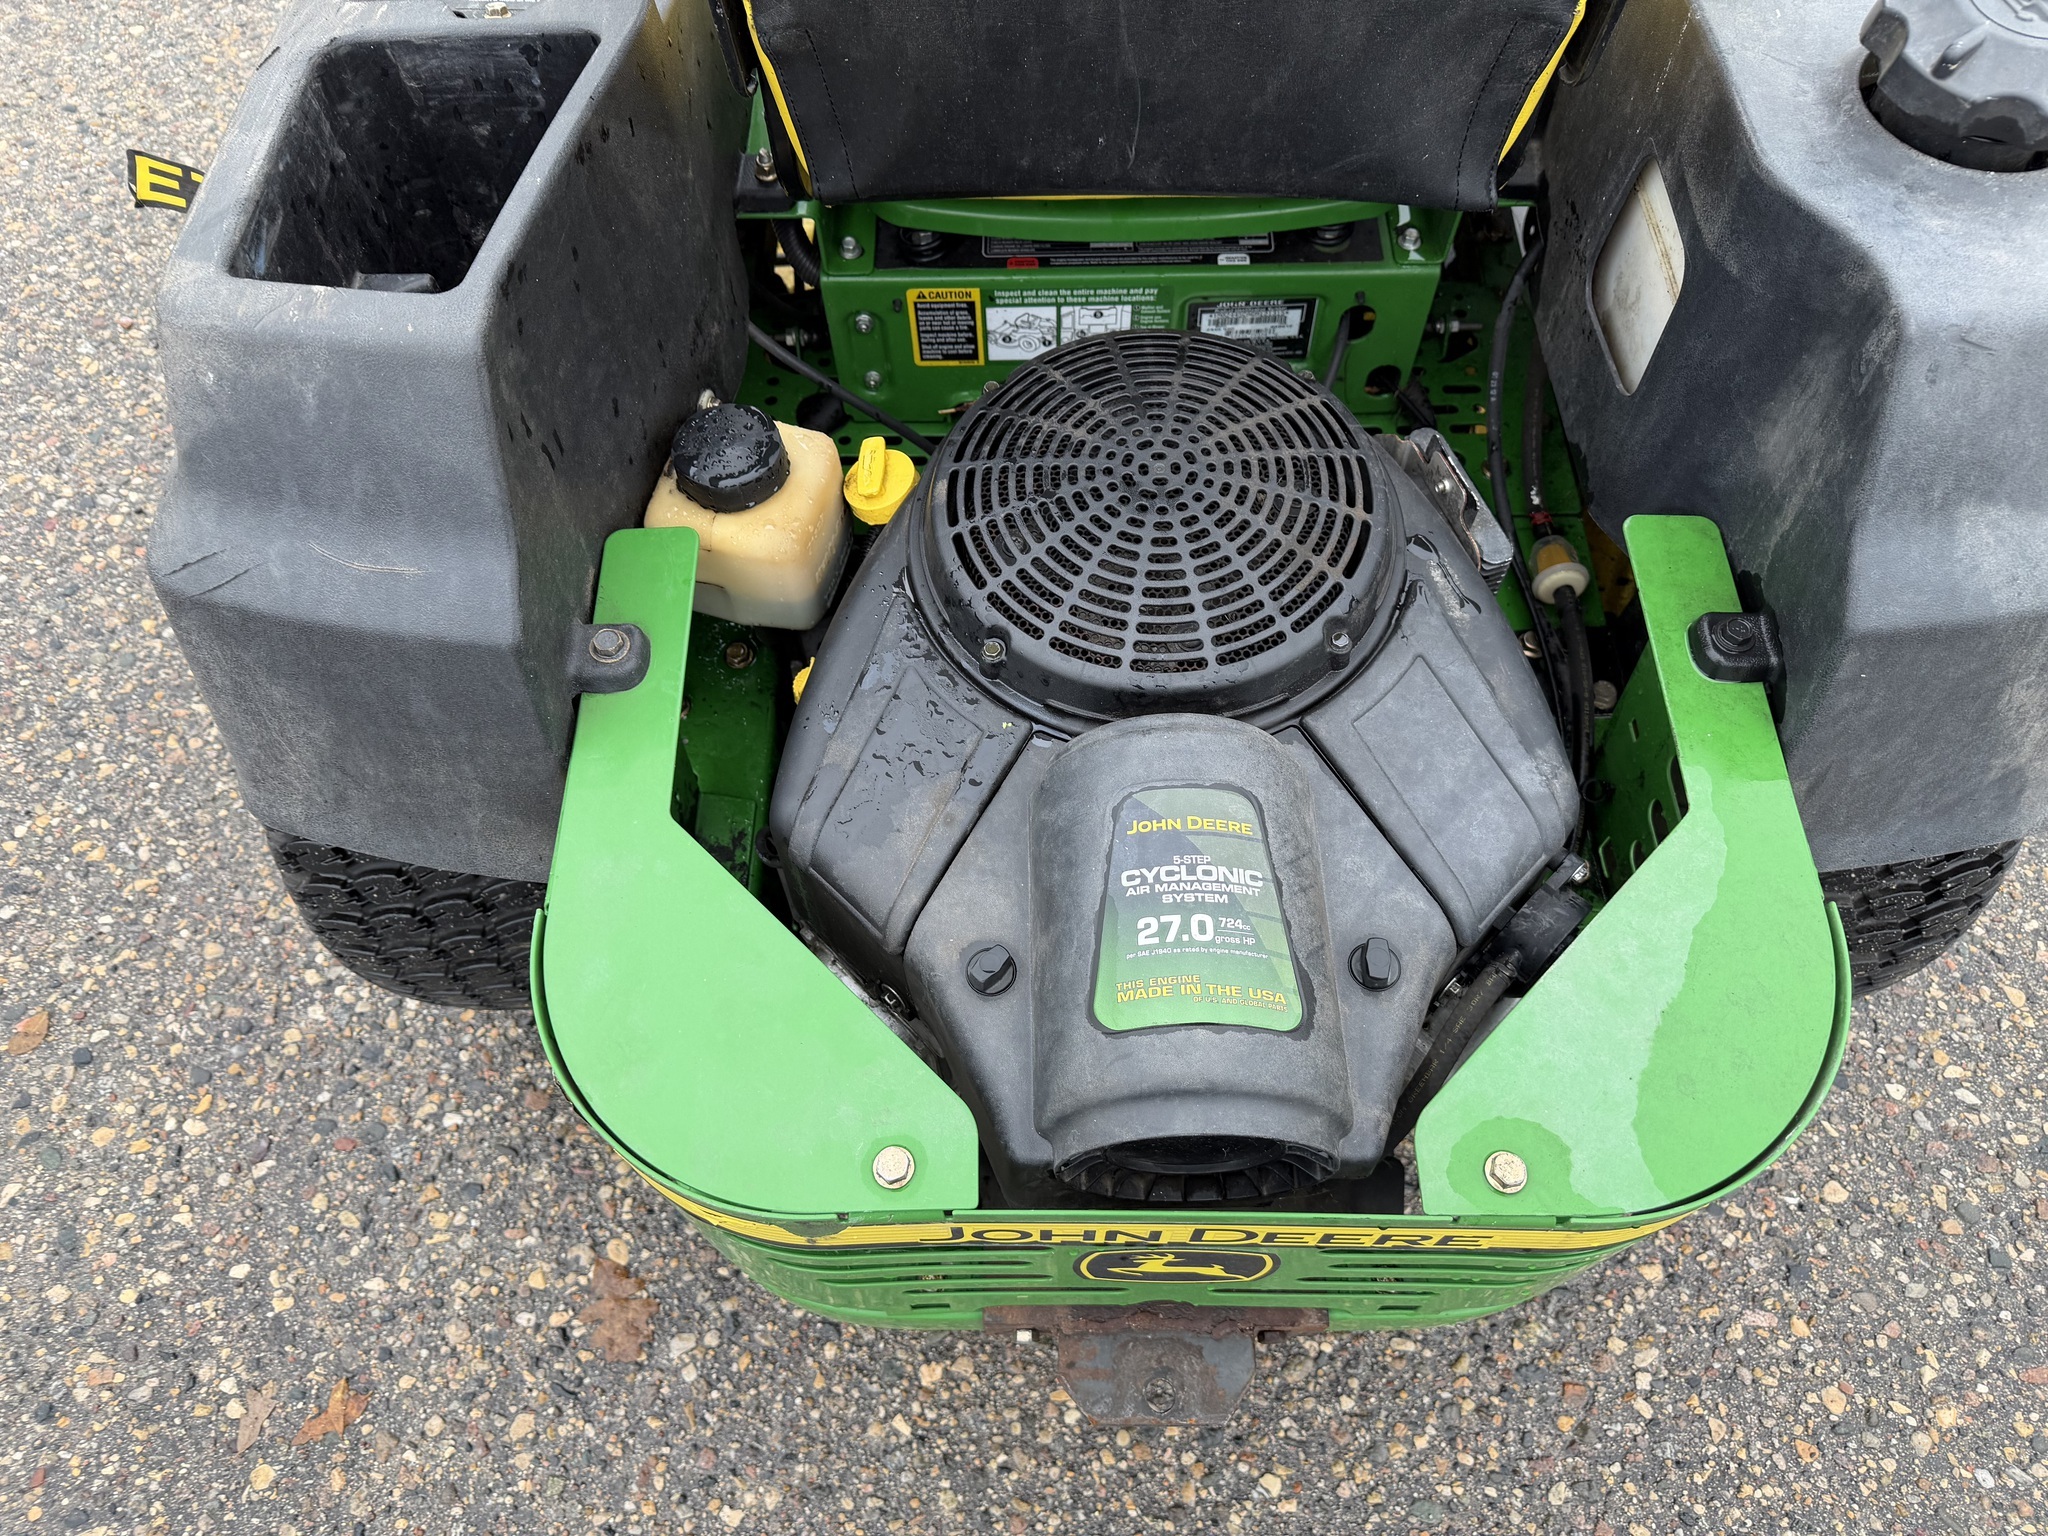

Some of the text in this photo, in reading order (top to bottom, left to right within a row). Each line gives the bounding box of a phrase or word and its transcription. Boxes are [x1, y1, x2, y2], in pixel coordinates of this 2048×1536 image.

[134, 155, 205, 208] E
[928, 290, 972, 300] CAUTION
[994, 290, 1021, 298] Inspect
[1126, 816, 1254, 835] JOHN DEERE
[1173, 855, 1211, 864] 5-STEP
[1120, 864, 1264, 887] CYCLONIC
[1126, 882, 1261, 896] AIR MANAGEMENT
[1162, 894, 1228, 904] SYSTEM
[1136, 914, 1214, 946] 27.0
[1214, 935, 1256, 946] gross HP
[1230, 948, 1269, 959] manufacturer
[1116, 974, 1200, 991] THIS ENGINE
[1116, 984, 1288, 1004] MADE IN THE USA
[1240, 999, 1266, 1009] GLOBAL
[1268, 1003, 1288, 1013] PARTS
[920, 1226, 1494, 1248] JOHN DEERE
